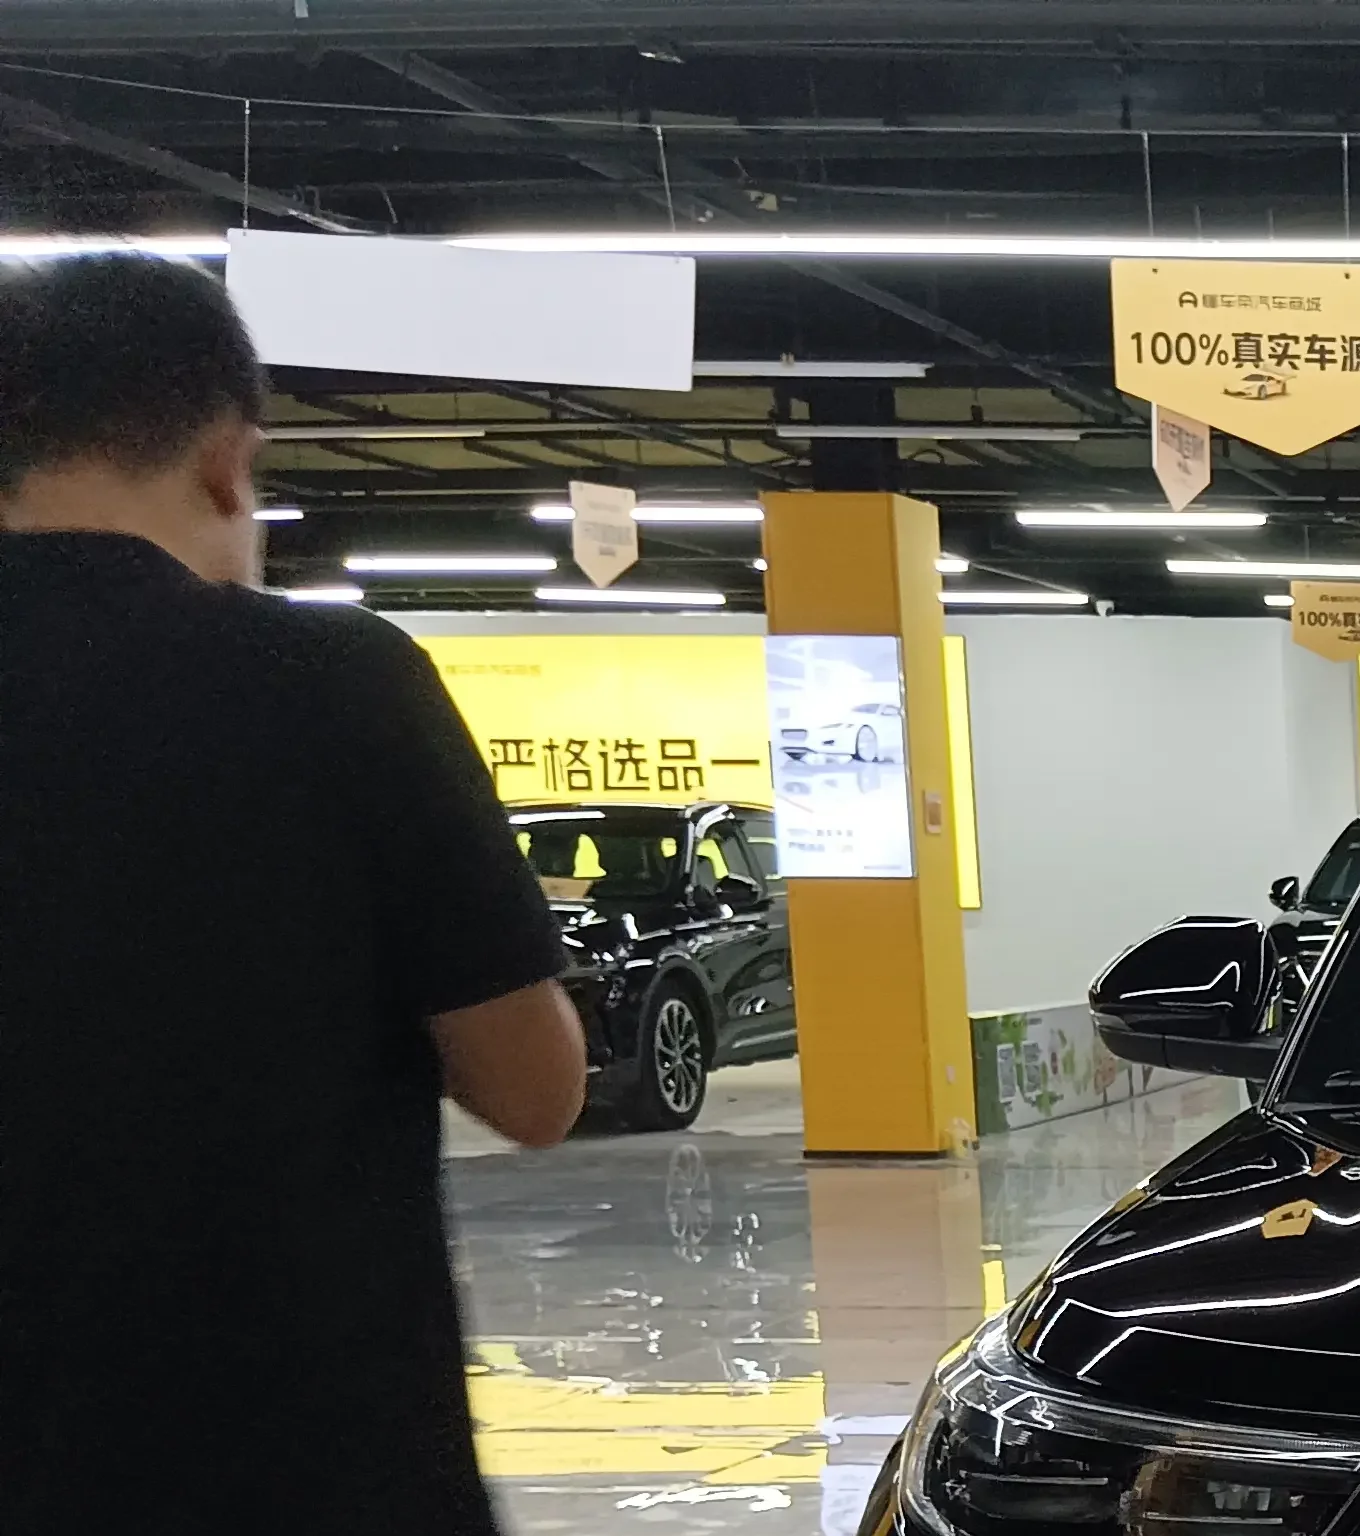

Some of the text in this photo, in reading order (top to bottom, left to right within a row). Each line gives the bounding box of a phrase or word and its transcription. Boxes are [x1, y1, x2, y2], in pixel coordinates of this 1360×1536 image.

[489, 737, 775, 792] 严格选品一
